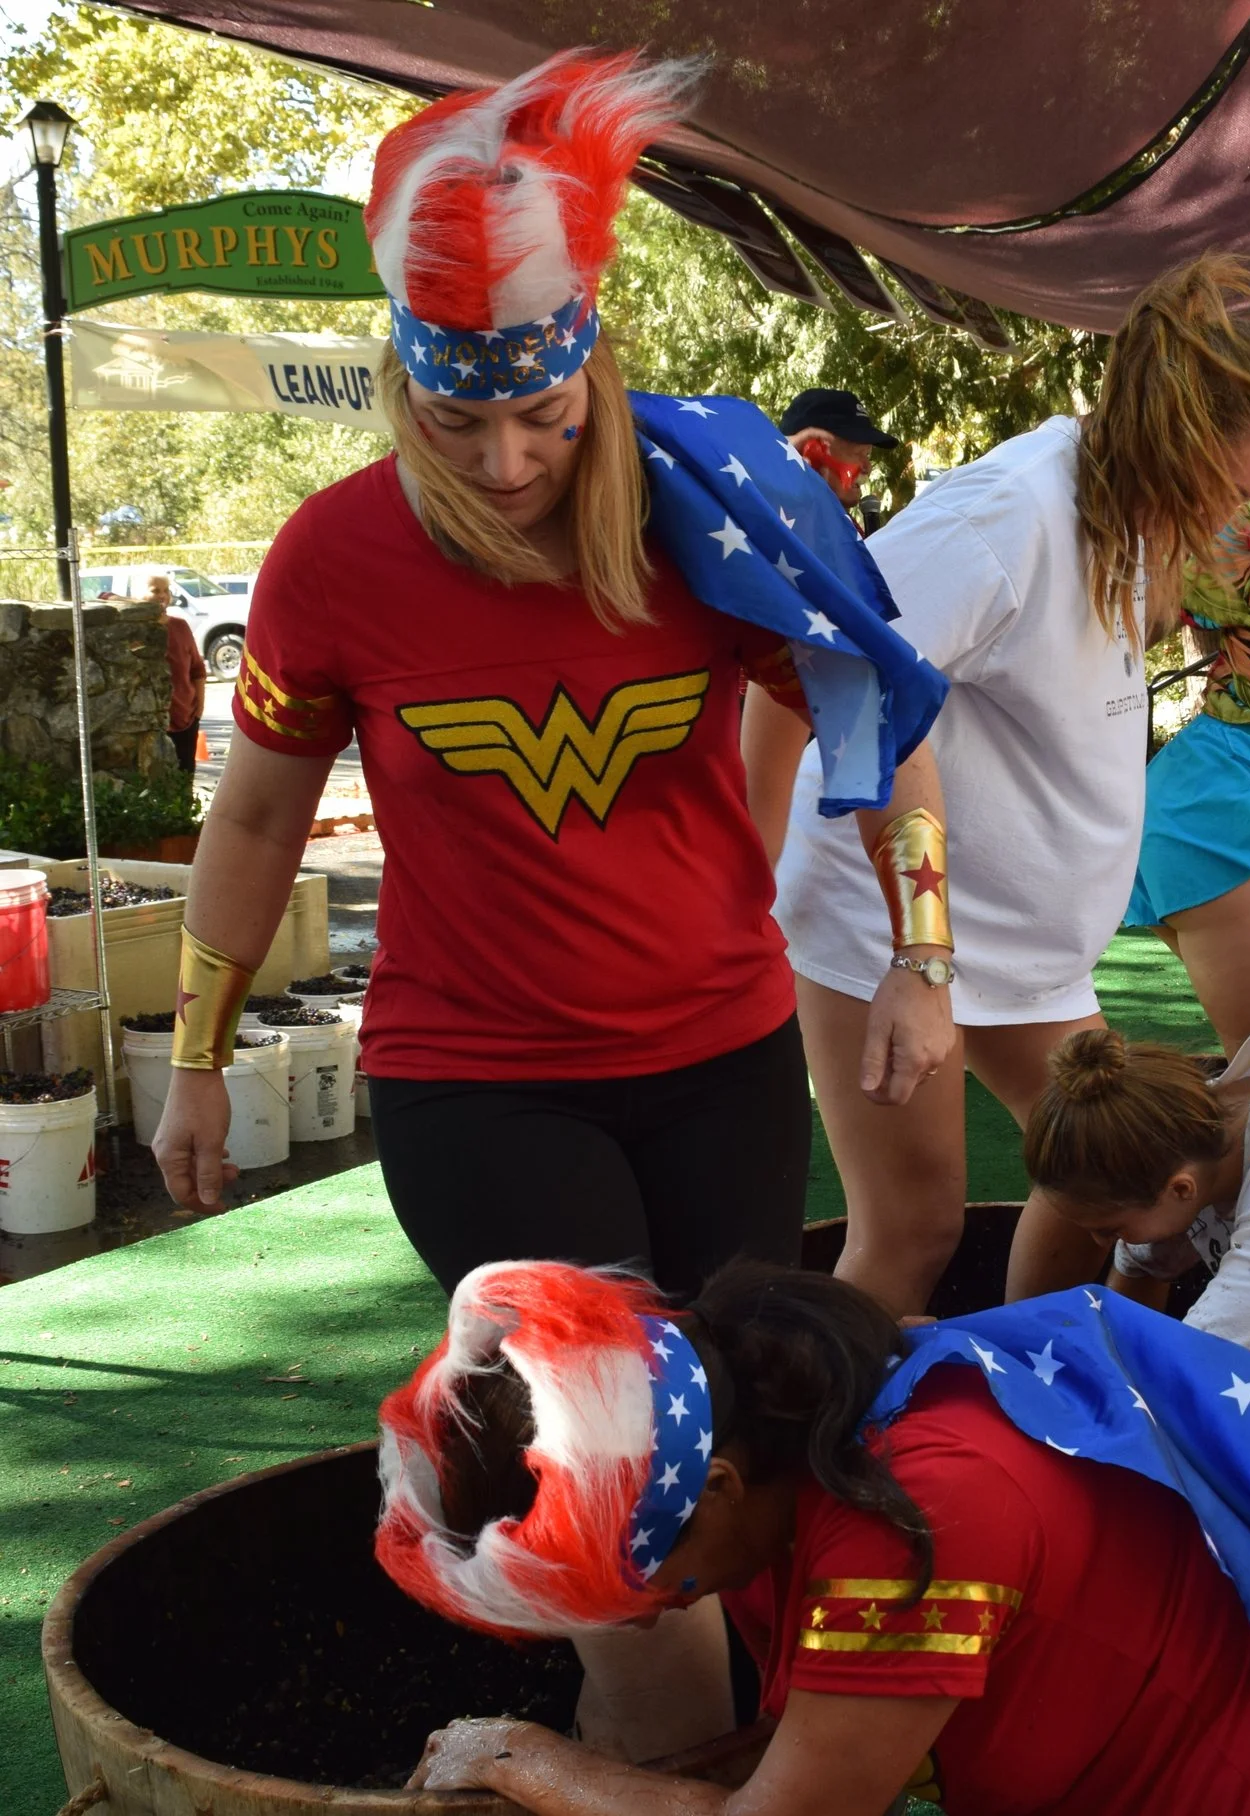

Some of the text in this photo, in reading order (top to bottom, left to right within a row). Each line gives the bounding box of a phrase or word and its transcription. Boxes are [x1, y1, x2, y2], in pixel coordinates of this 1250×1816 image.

[242, 201, 351, 223] Come Again!
[83, 225, 339, 285] MURPHYS
[255, 275, 317, 288] Established
[430, 322, 563, 367] WONDER
[264, 363, 375, 411] LEAN-UP
